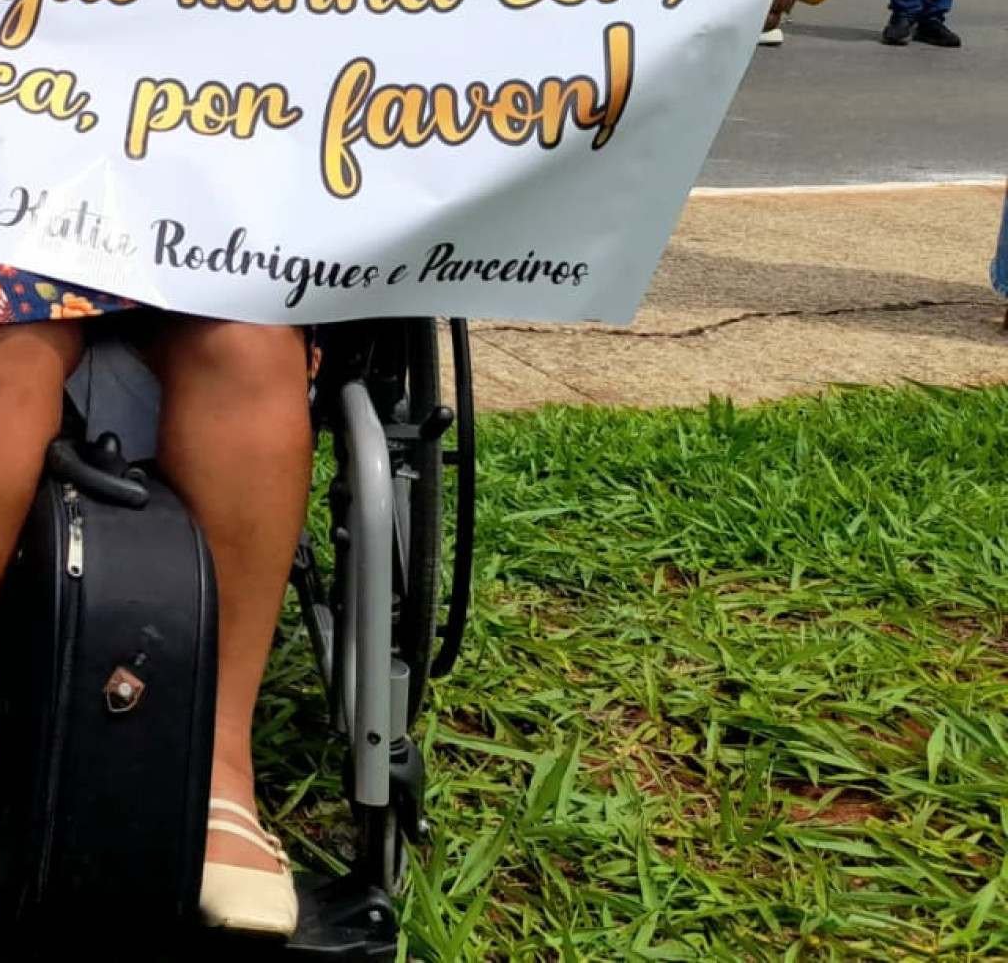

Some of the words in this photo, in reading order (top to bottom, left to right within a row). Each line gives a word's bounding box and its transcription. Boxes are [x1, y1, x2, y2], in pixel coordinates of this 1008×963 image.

[124, 77, 303, 160] por
[320, 22, 636, 199] favor!
[150, 219, 379, 307] Rodrigues
[387, 267, 408, 287] e
[417, 242, 589, 286] Parceiros
